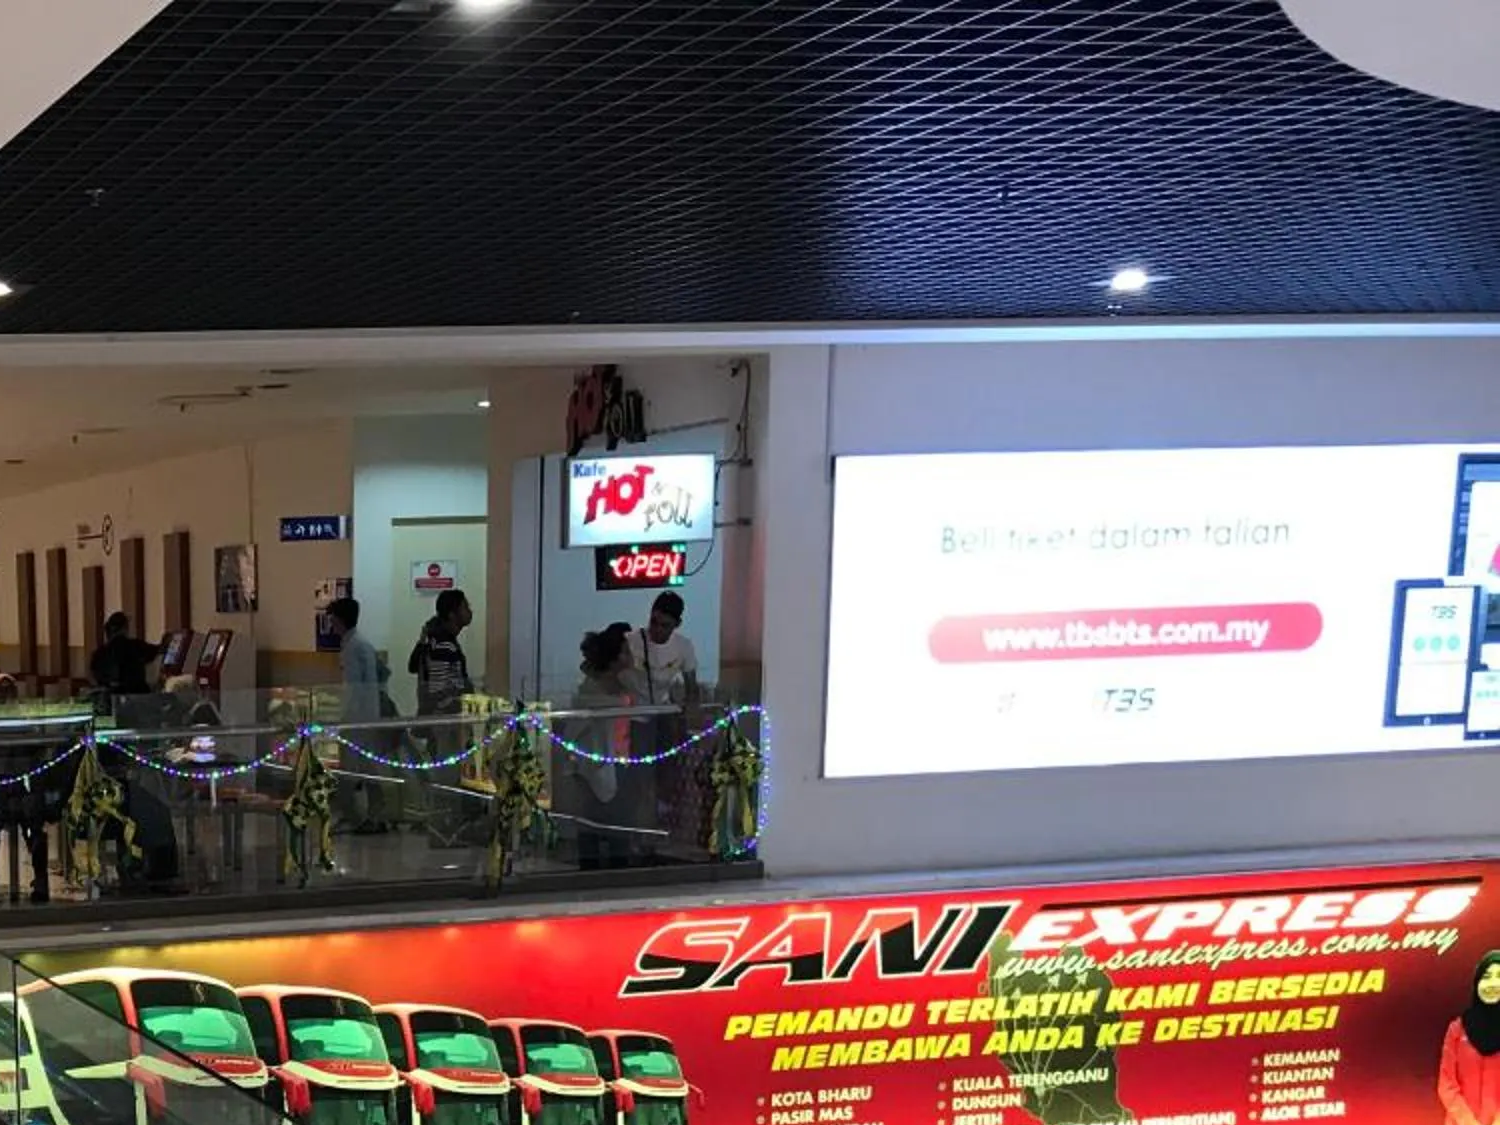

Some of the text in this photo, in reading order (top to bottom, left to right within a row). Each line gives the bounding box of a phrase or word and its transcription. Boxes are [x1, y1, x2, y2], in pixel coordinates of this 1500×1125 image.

[584, 465, 654, 524] HOT
[614, 553, 681, 578] OPEN
[619, 886, 1480, 997] SANI EXPRESS
[994, 927, 1458, 980] www.saniexpress.com.my
[724, 969, 1386, 1041] PEMANDU TERLATIH KAMI BERSEDIA
[771, 1006, 1340, 1071] MEMBAWA ANDA KE DESTINASI
[1263, 1048, 1341, 1068] KEMAMAN
[952, 1068, 1109, 1093] KUALA TERENGGANU
[1262, 1067, 1334, 1085] KUANTAN
[771, 1086, 872, 1107] KOTA BHARU
[952, 1093, 1022, 1111] DUNGUN
[1261, 1086, 1325, 1104] KANGAR
[771, 1106, 853, 1125] PASIR MAS
